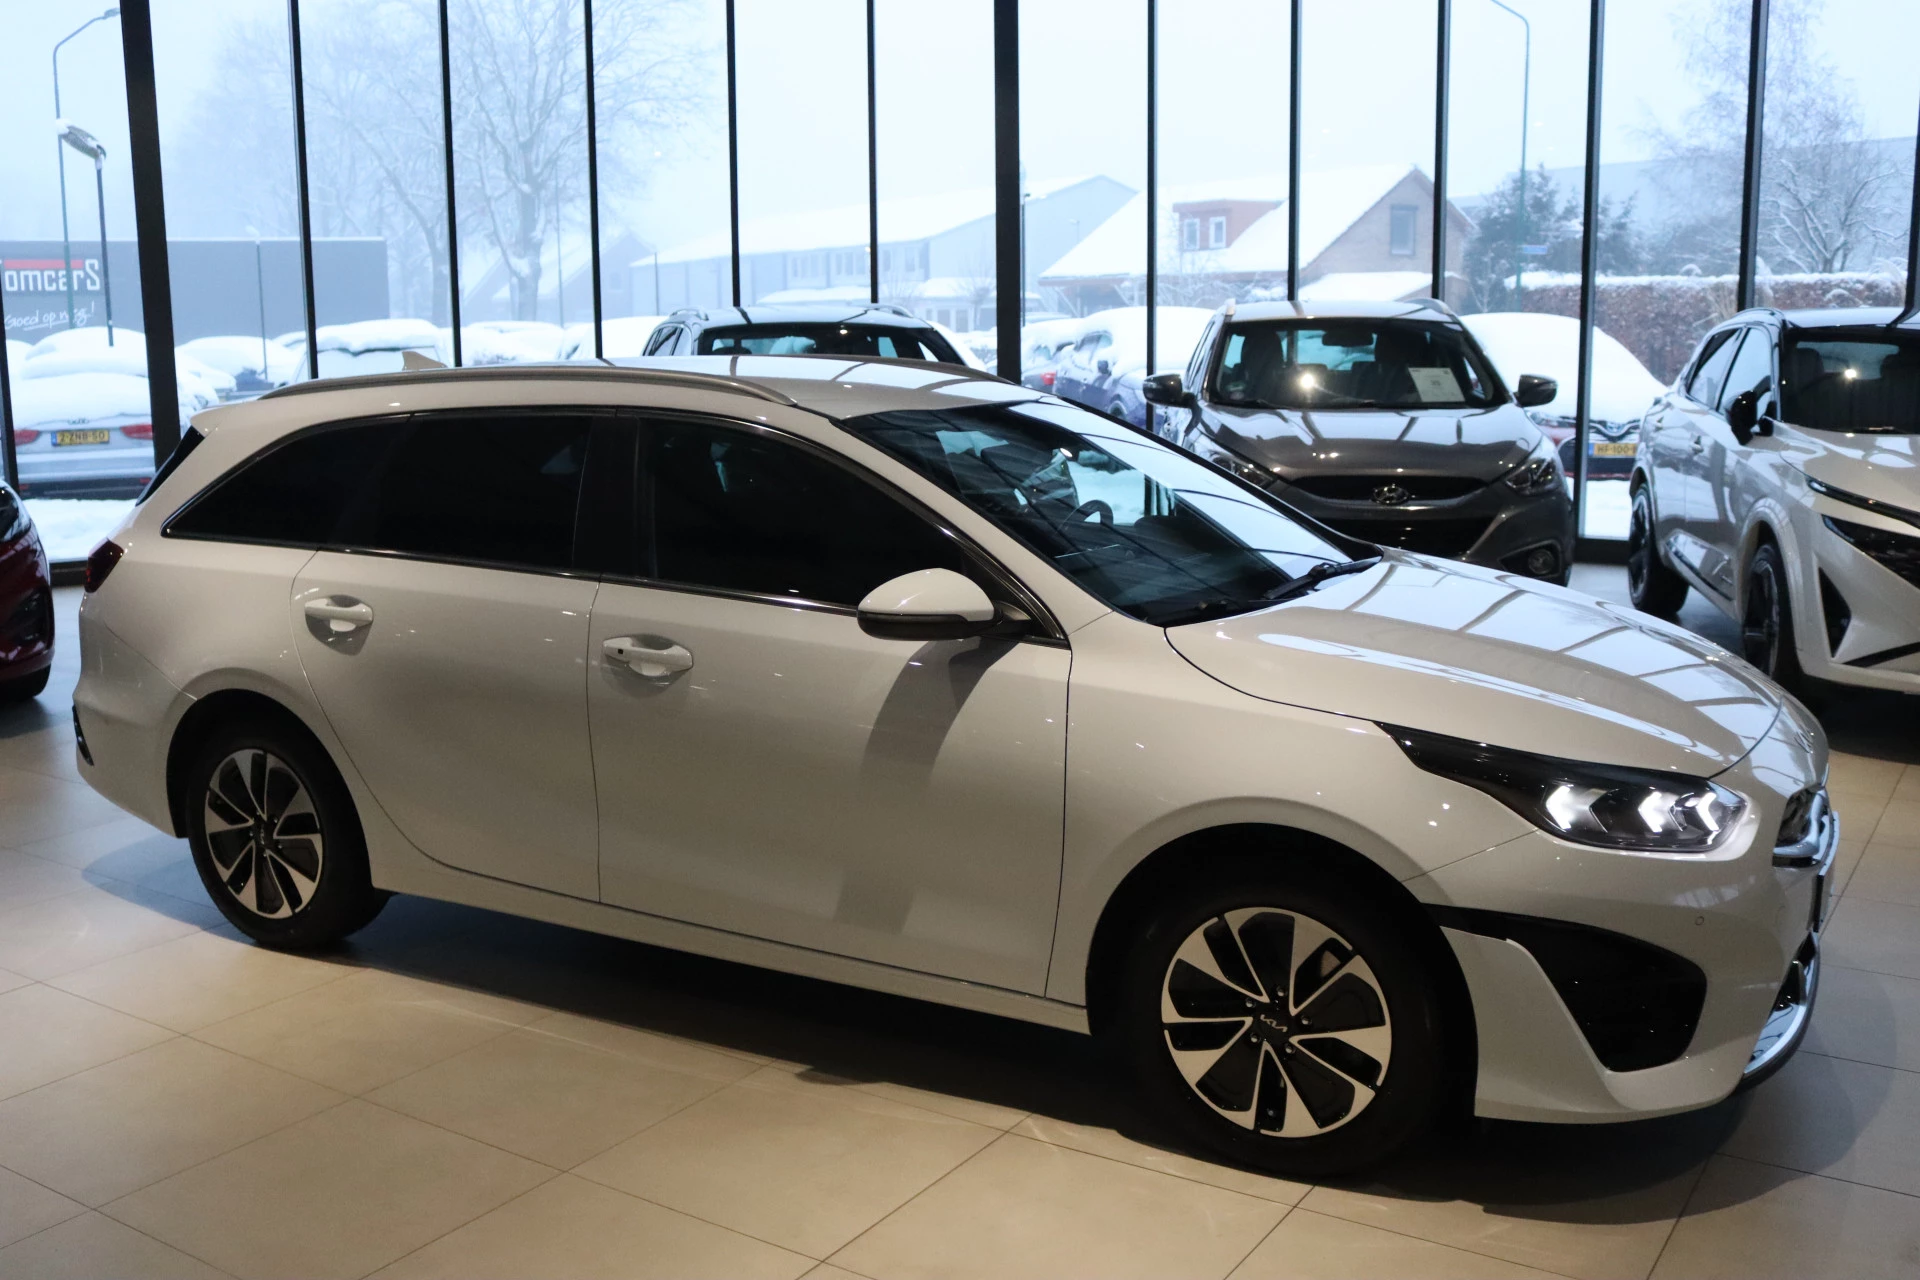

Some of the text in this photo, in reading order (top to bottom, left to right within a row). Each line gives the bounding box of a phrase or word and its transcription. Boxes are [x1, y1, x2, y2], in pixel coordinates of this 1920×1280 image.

[0, 259, 101, 291] omcarS
[5, 309, 39, 330] Goed
[43, 311, 56, 329] op
